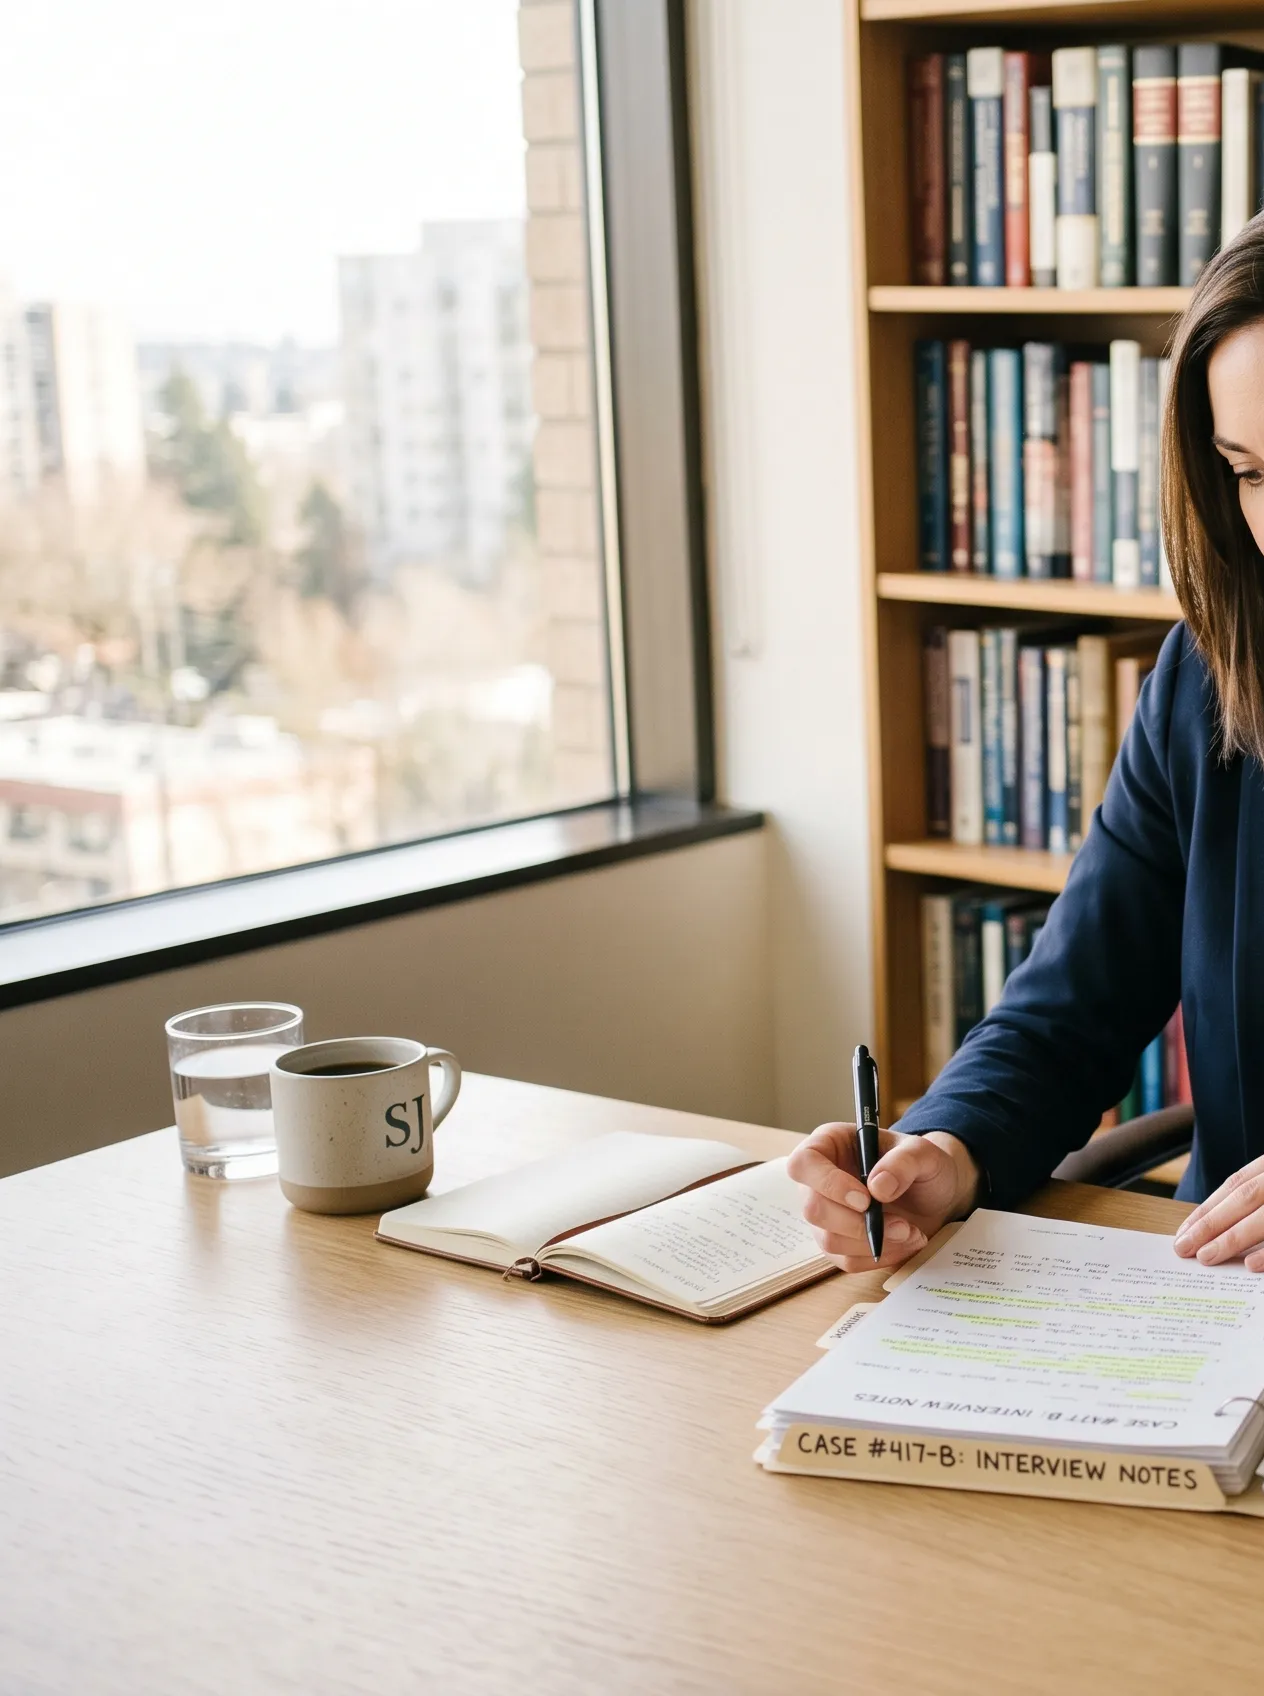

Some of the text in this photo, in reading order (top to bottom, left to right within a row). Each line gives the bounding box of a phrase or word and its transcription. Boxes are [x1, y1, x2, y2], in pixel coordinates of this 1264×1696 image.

[384, 1094, 425, 1155] SJ
[853, 1392, 919, 1407] NOTES
[921, 1400, 1034, 1419] INTERVIEW
[797, 1432, 1198, 1491] CASE #417-B: INTERVIEW NOTES
